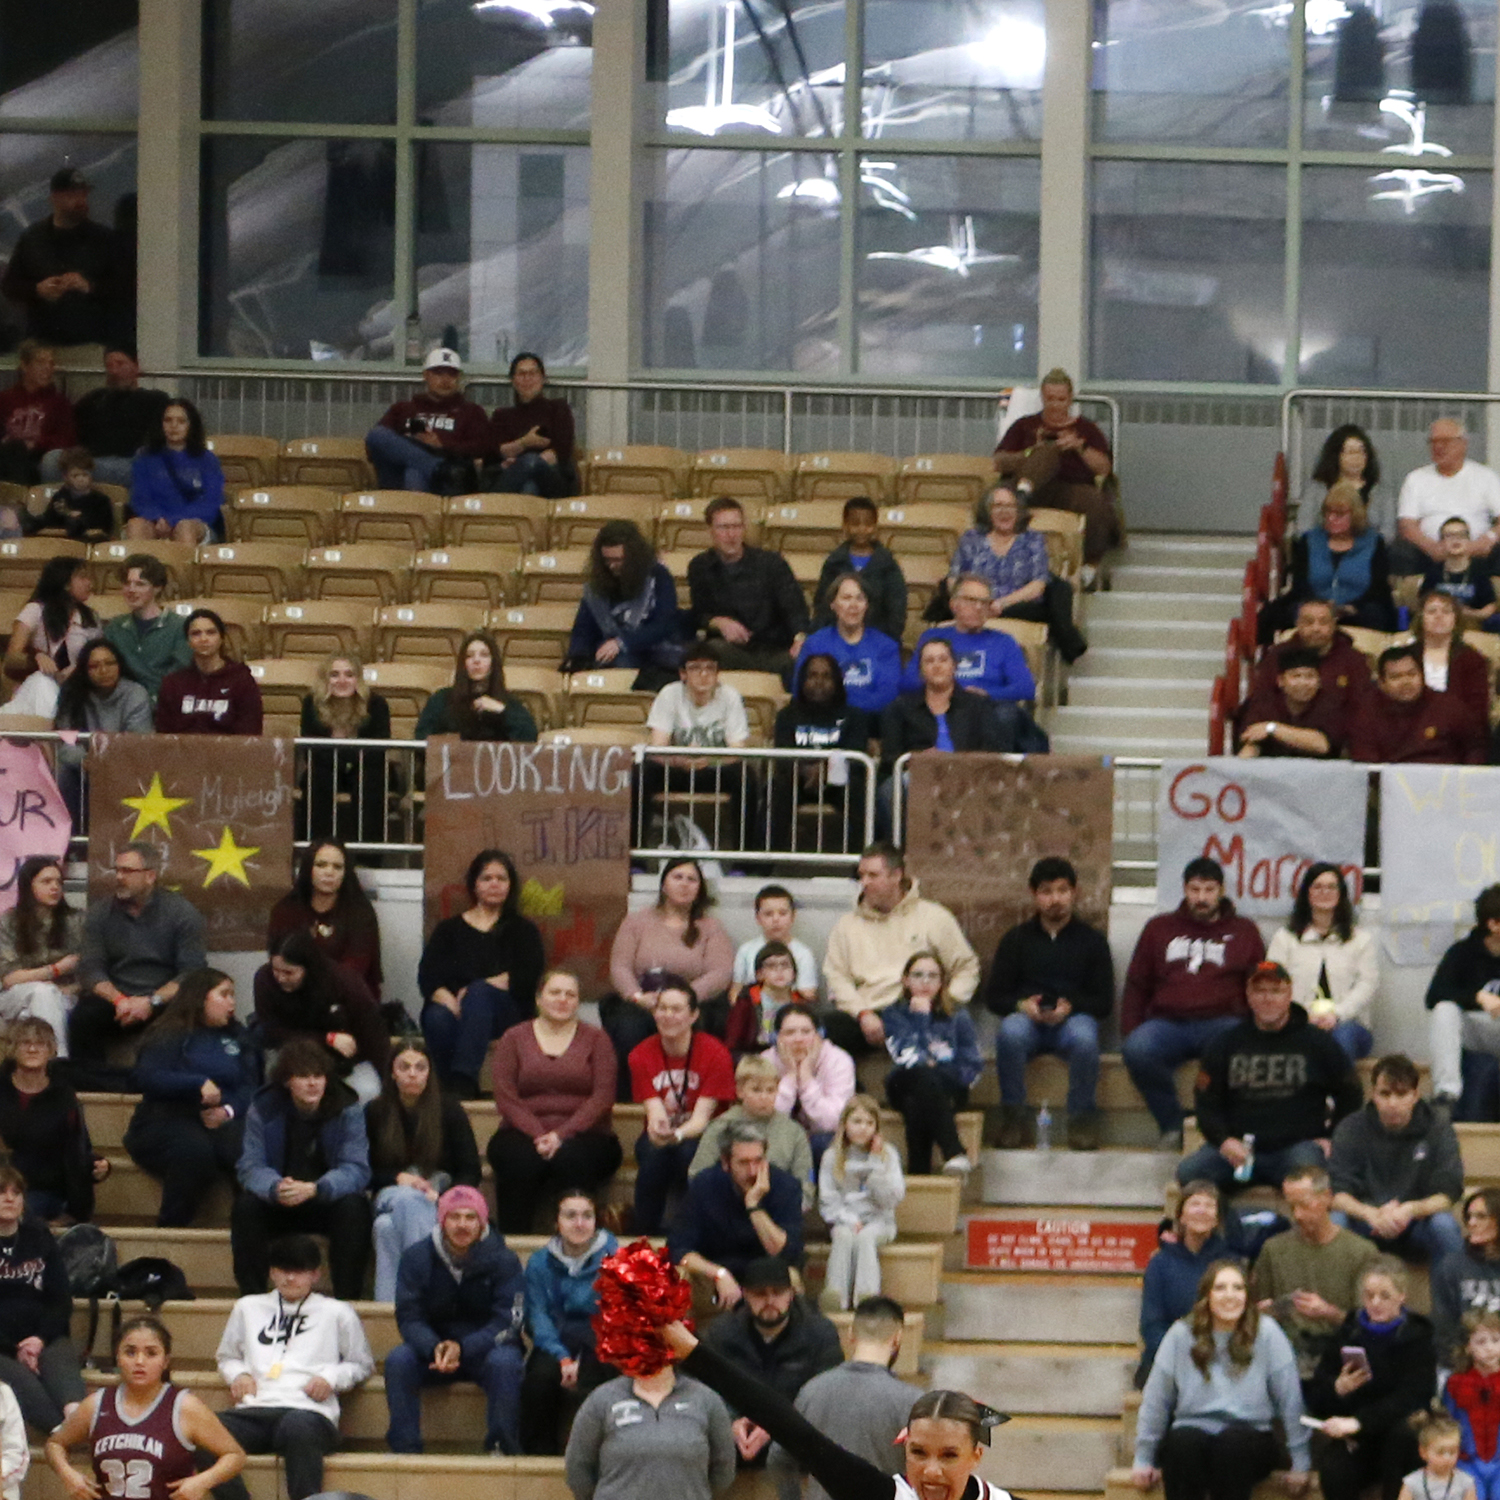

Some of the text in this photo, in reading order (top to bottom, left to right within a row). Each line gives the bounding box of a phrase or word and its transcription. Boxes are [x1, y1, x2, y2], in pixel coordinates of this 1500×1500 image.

[441, 742, 629, 799] LOOKING
[1229, 1053, 1307, 1089] BEER
[94, 1433, 164, 1458] KETCHIKAN
[101, 1459, 154, 1498] 32
